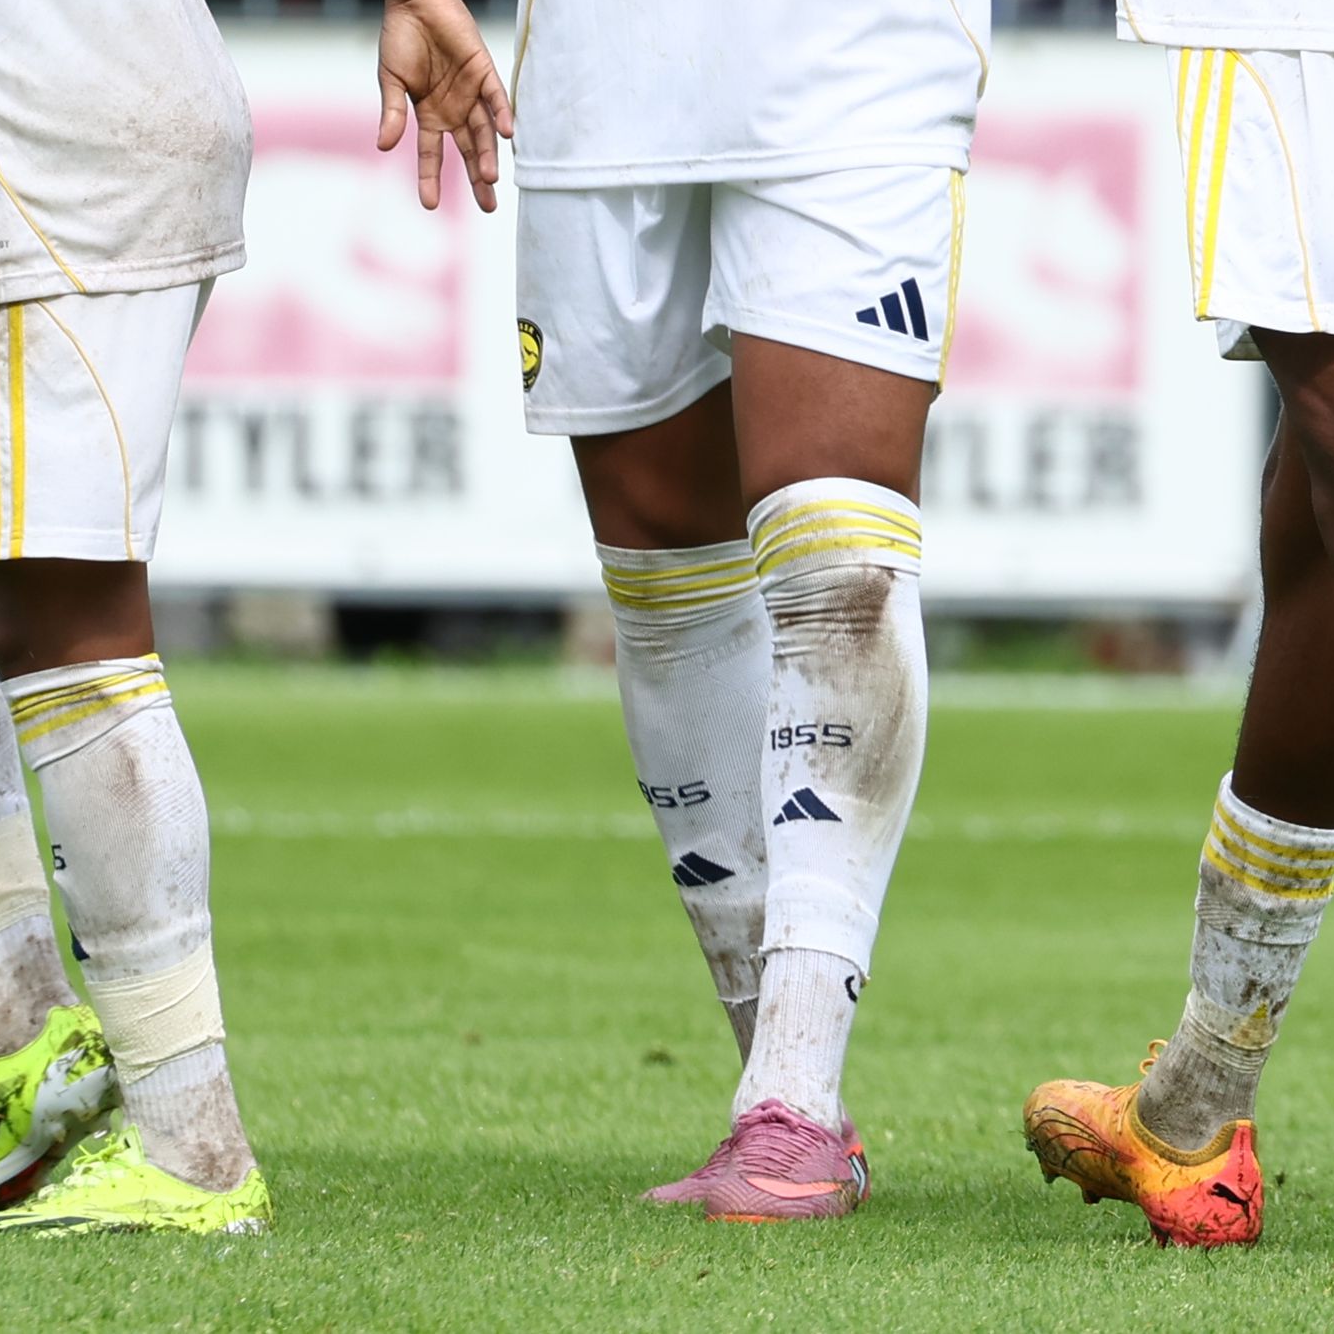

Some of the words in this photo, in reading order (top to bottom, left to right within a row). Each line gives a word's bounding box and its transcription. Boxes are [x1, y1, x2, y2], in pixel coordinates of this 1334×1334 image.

[180, 391, 467, 504] TYLER
[770, 723, 853, 751] 1955
[637, 780, 712, 809] 955
